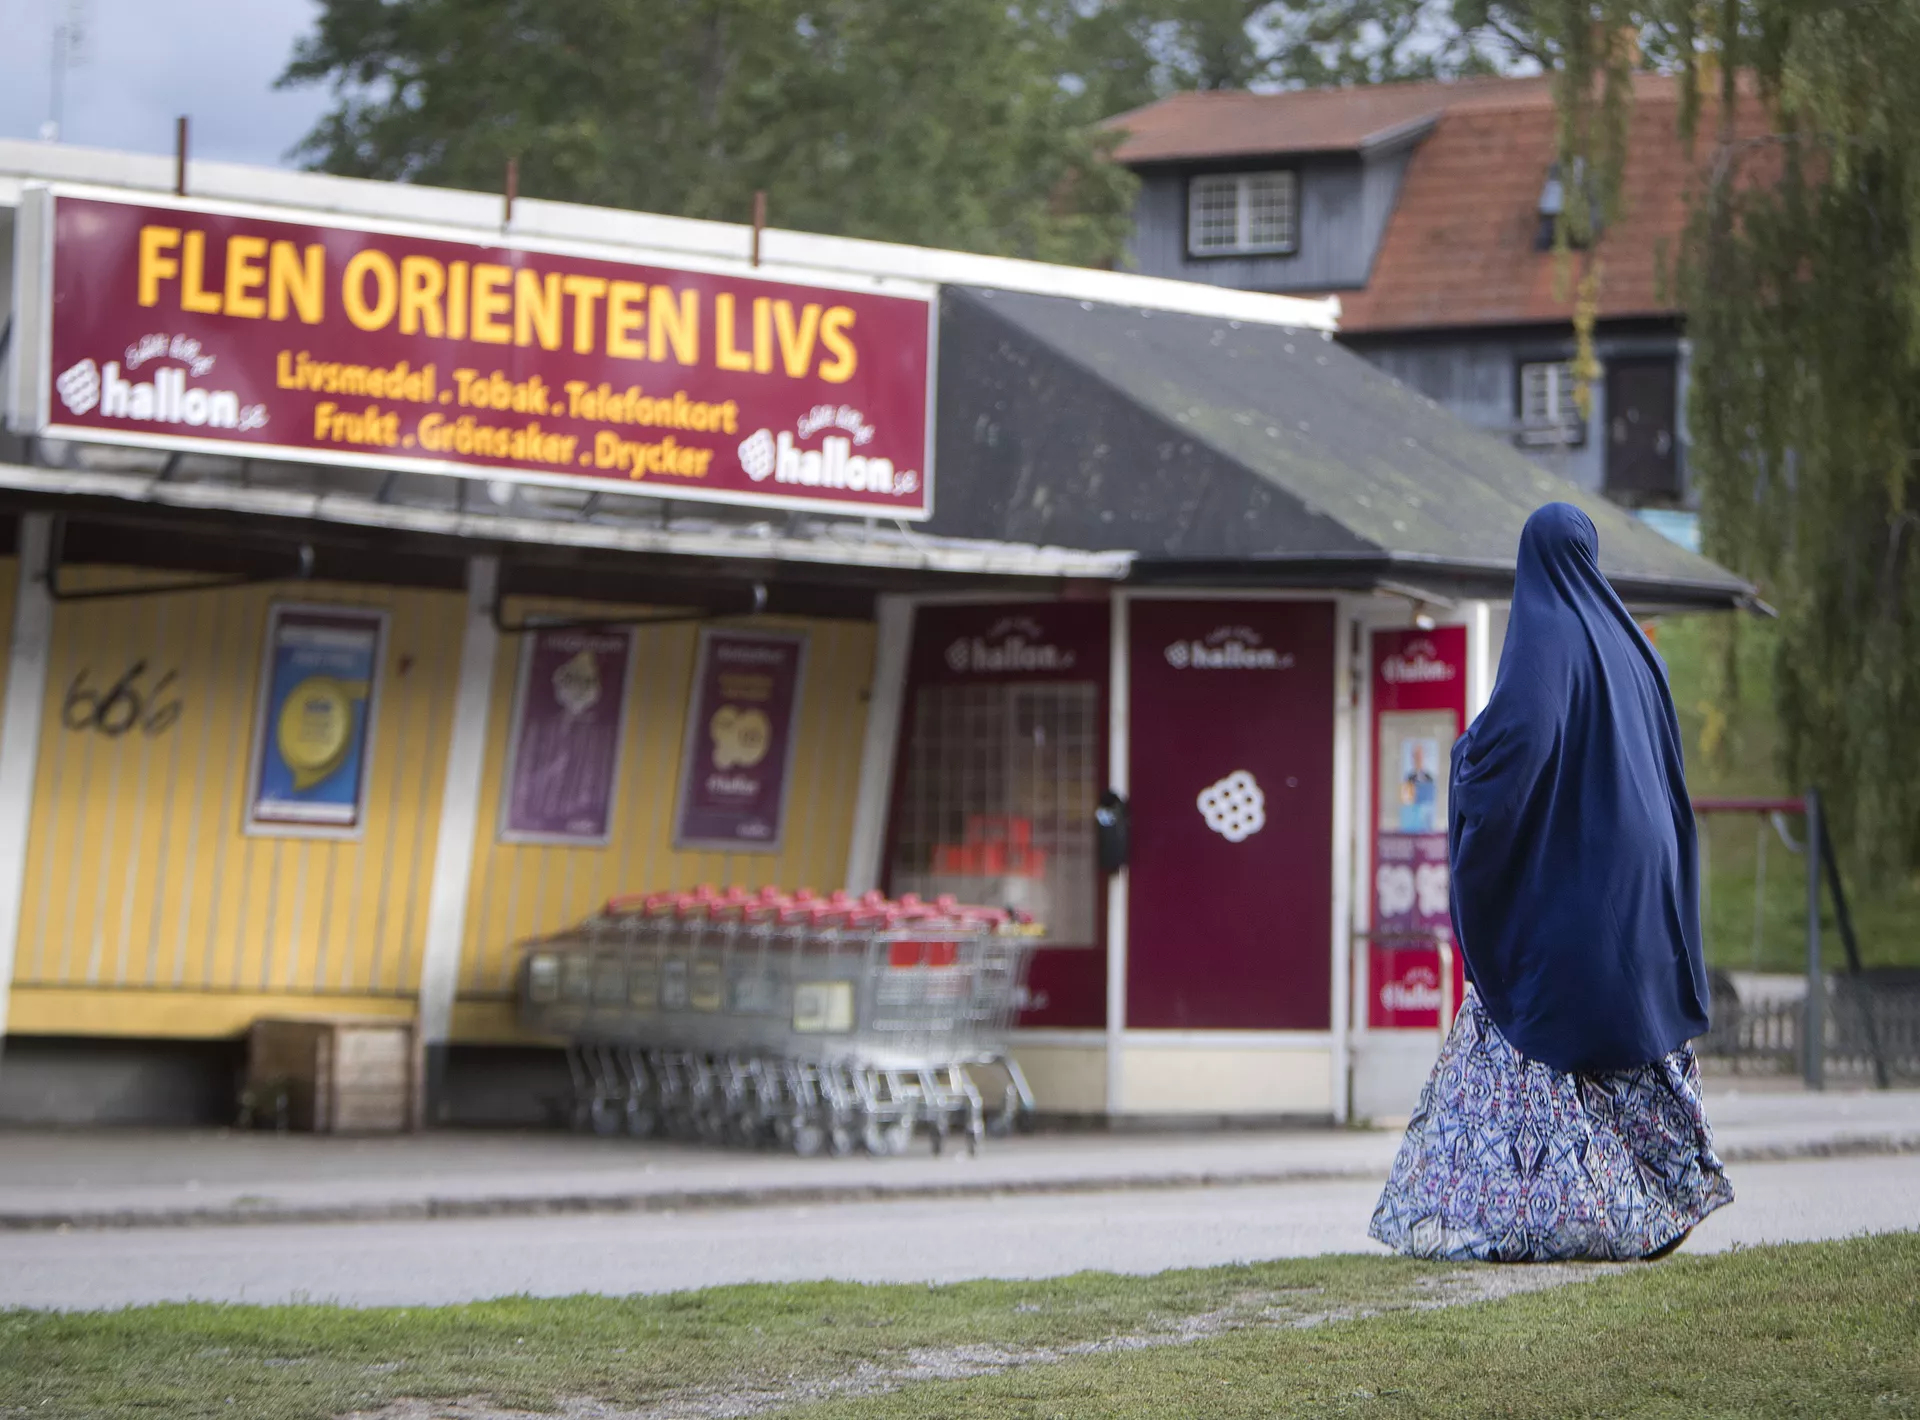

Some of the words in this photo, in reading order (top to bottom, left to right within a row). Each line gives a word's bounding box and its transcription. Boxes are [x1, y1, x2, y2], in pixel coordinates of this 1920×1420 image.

[138, 225, 326, 325] FLEN
[342, 249, 699, 366] ORIENTEN
[715, 292, 858, 383] LIVS
[277, 351, 437, 403] Livsmedel
[453, 368, 550, 416] Tabak
[564, 380, 738, 435] Telefonkort
[314, 401, 400, 448] Frukt
[418, 412, 578, 466] Grönsaker
[594, 430, 713, 480] Drycker
